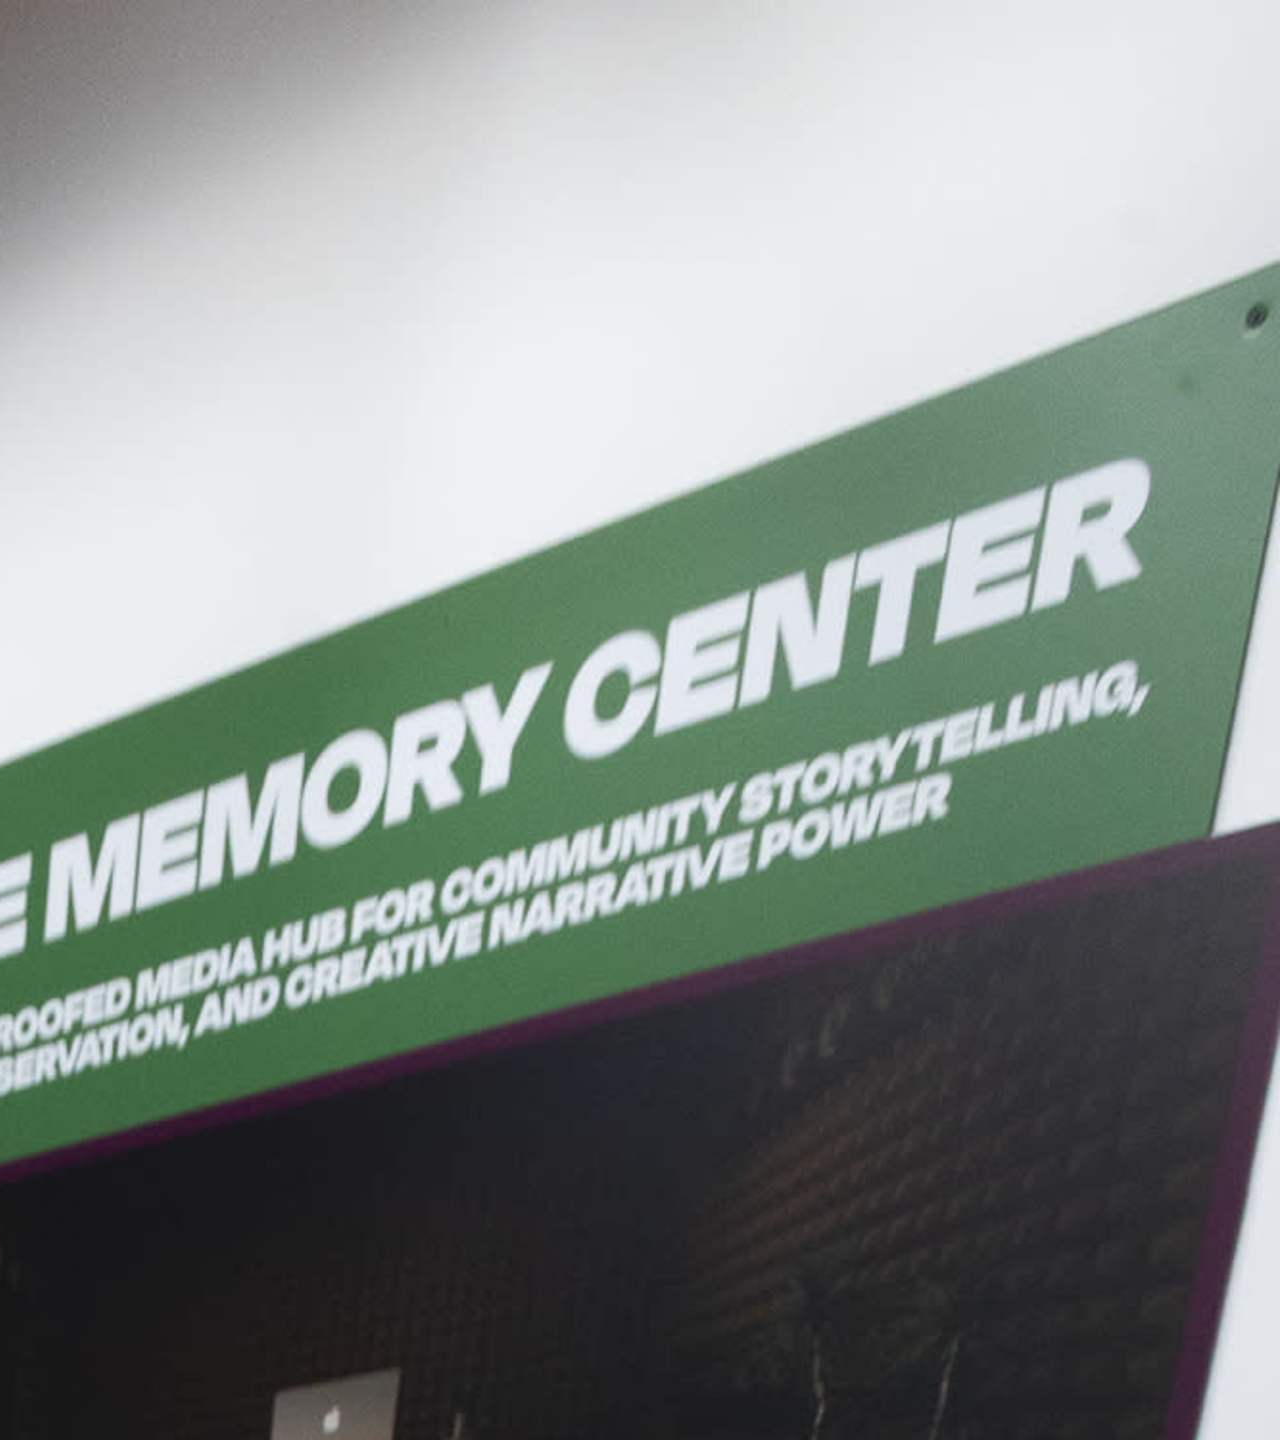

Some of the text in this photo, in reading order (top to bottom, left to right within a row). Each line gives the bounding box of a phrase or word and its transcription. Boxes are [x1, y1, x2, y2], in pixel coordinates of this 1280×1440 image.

[44, 660, 553, 942] MEMORY
[564, 457, 1150, 759] CENTER
[135, 936, 256, 1010] MEDIA
[262, 907, 346, 970] HUB
[350, 879, 434, 944] FOR
[440, 782, 736, 915] COMMUNITY
[738, 659, 1150, 822] STORYTELLING,
[194, 975, 280, 1037] AND
[285, 910, 484, 1009] CREATIVE
[488, 829, 752, 950] NARRATIVE
[757, 771, 951, 870] POWER
